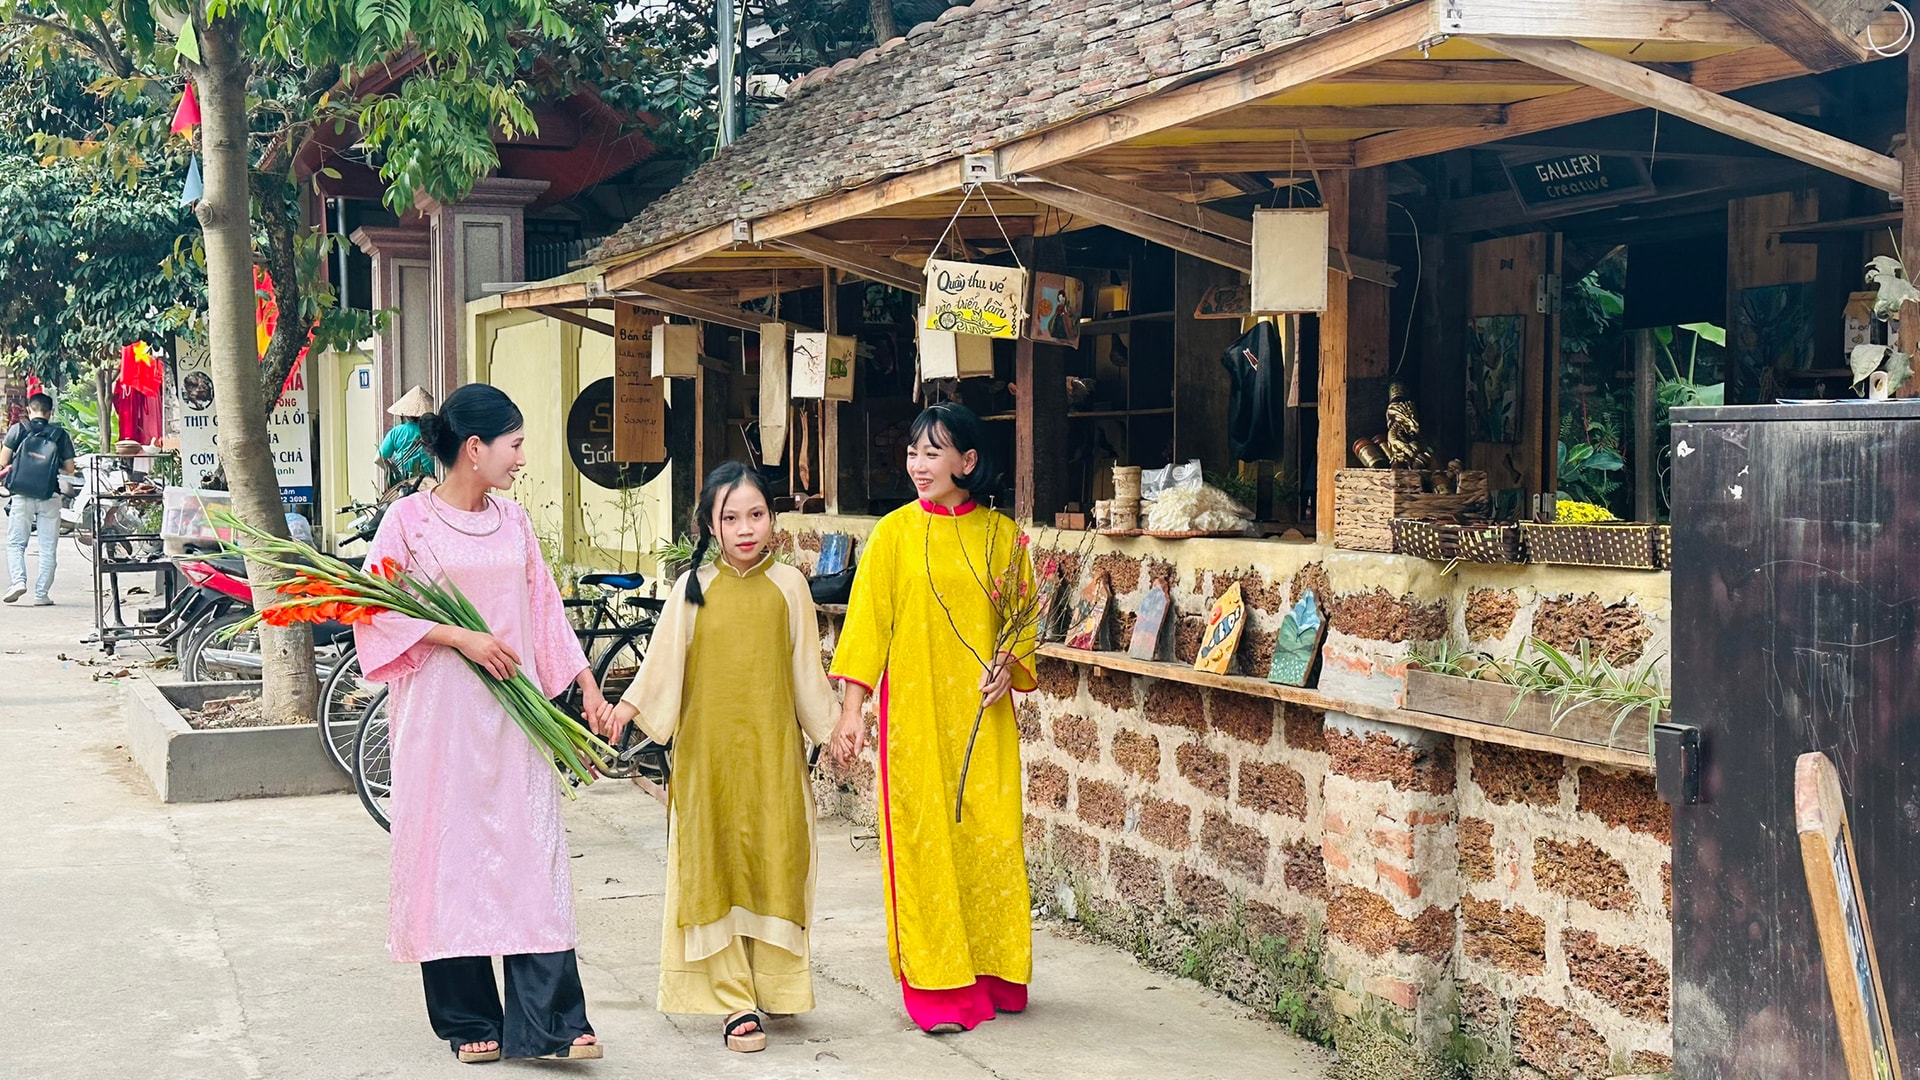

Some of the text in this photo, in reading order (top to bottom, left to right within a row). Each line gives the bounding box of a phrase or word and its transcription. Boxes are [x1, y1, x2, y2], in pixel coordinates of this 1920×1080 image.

[1535, 154, 1601, 182] GALLERY
[968, 270, 986, 290] thu
[989, 276, 1007, 293] vé
[184, 415, 209, 430] THỊT
[275, 411, 290, 425] LÁ
[190, 453, 215, 465] CƠM
[279, 447, 303, 463] CHẢ
